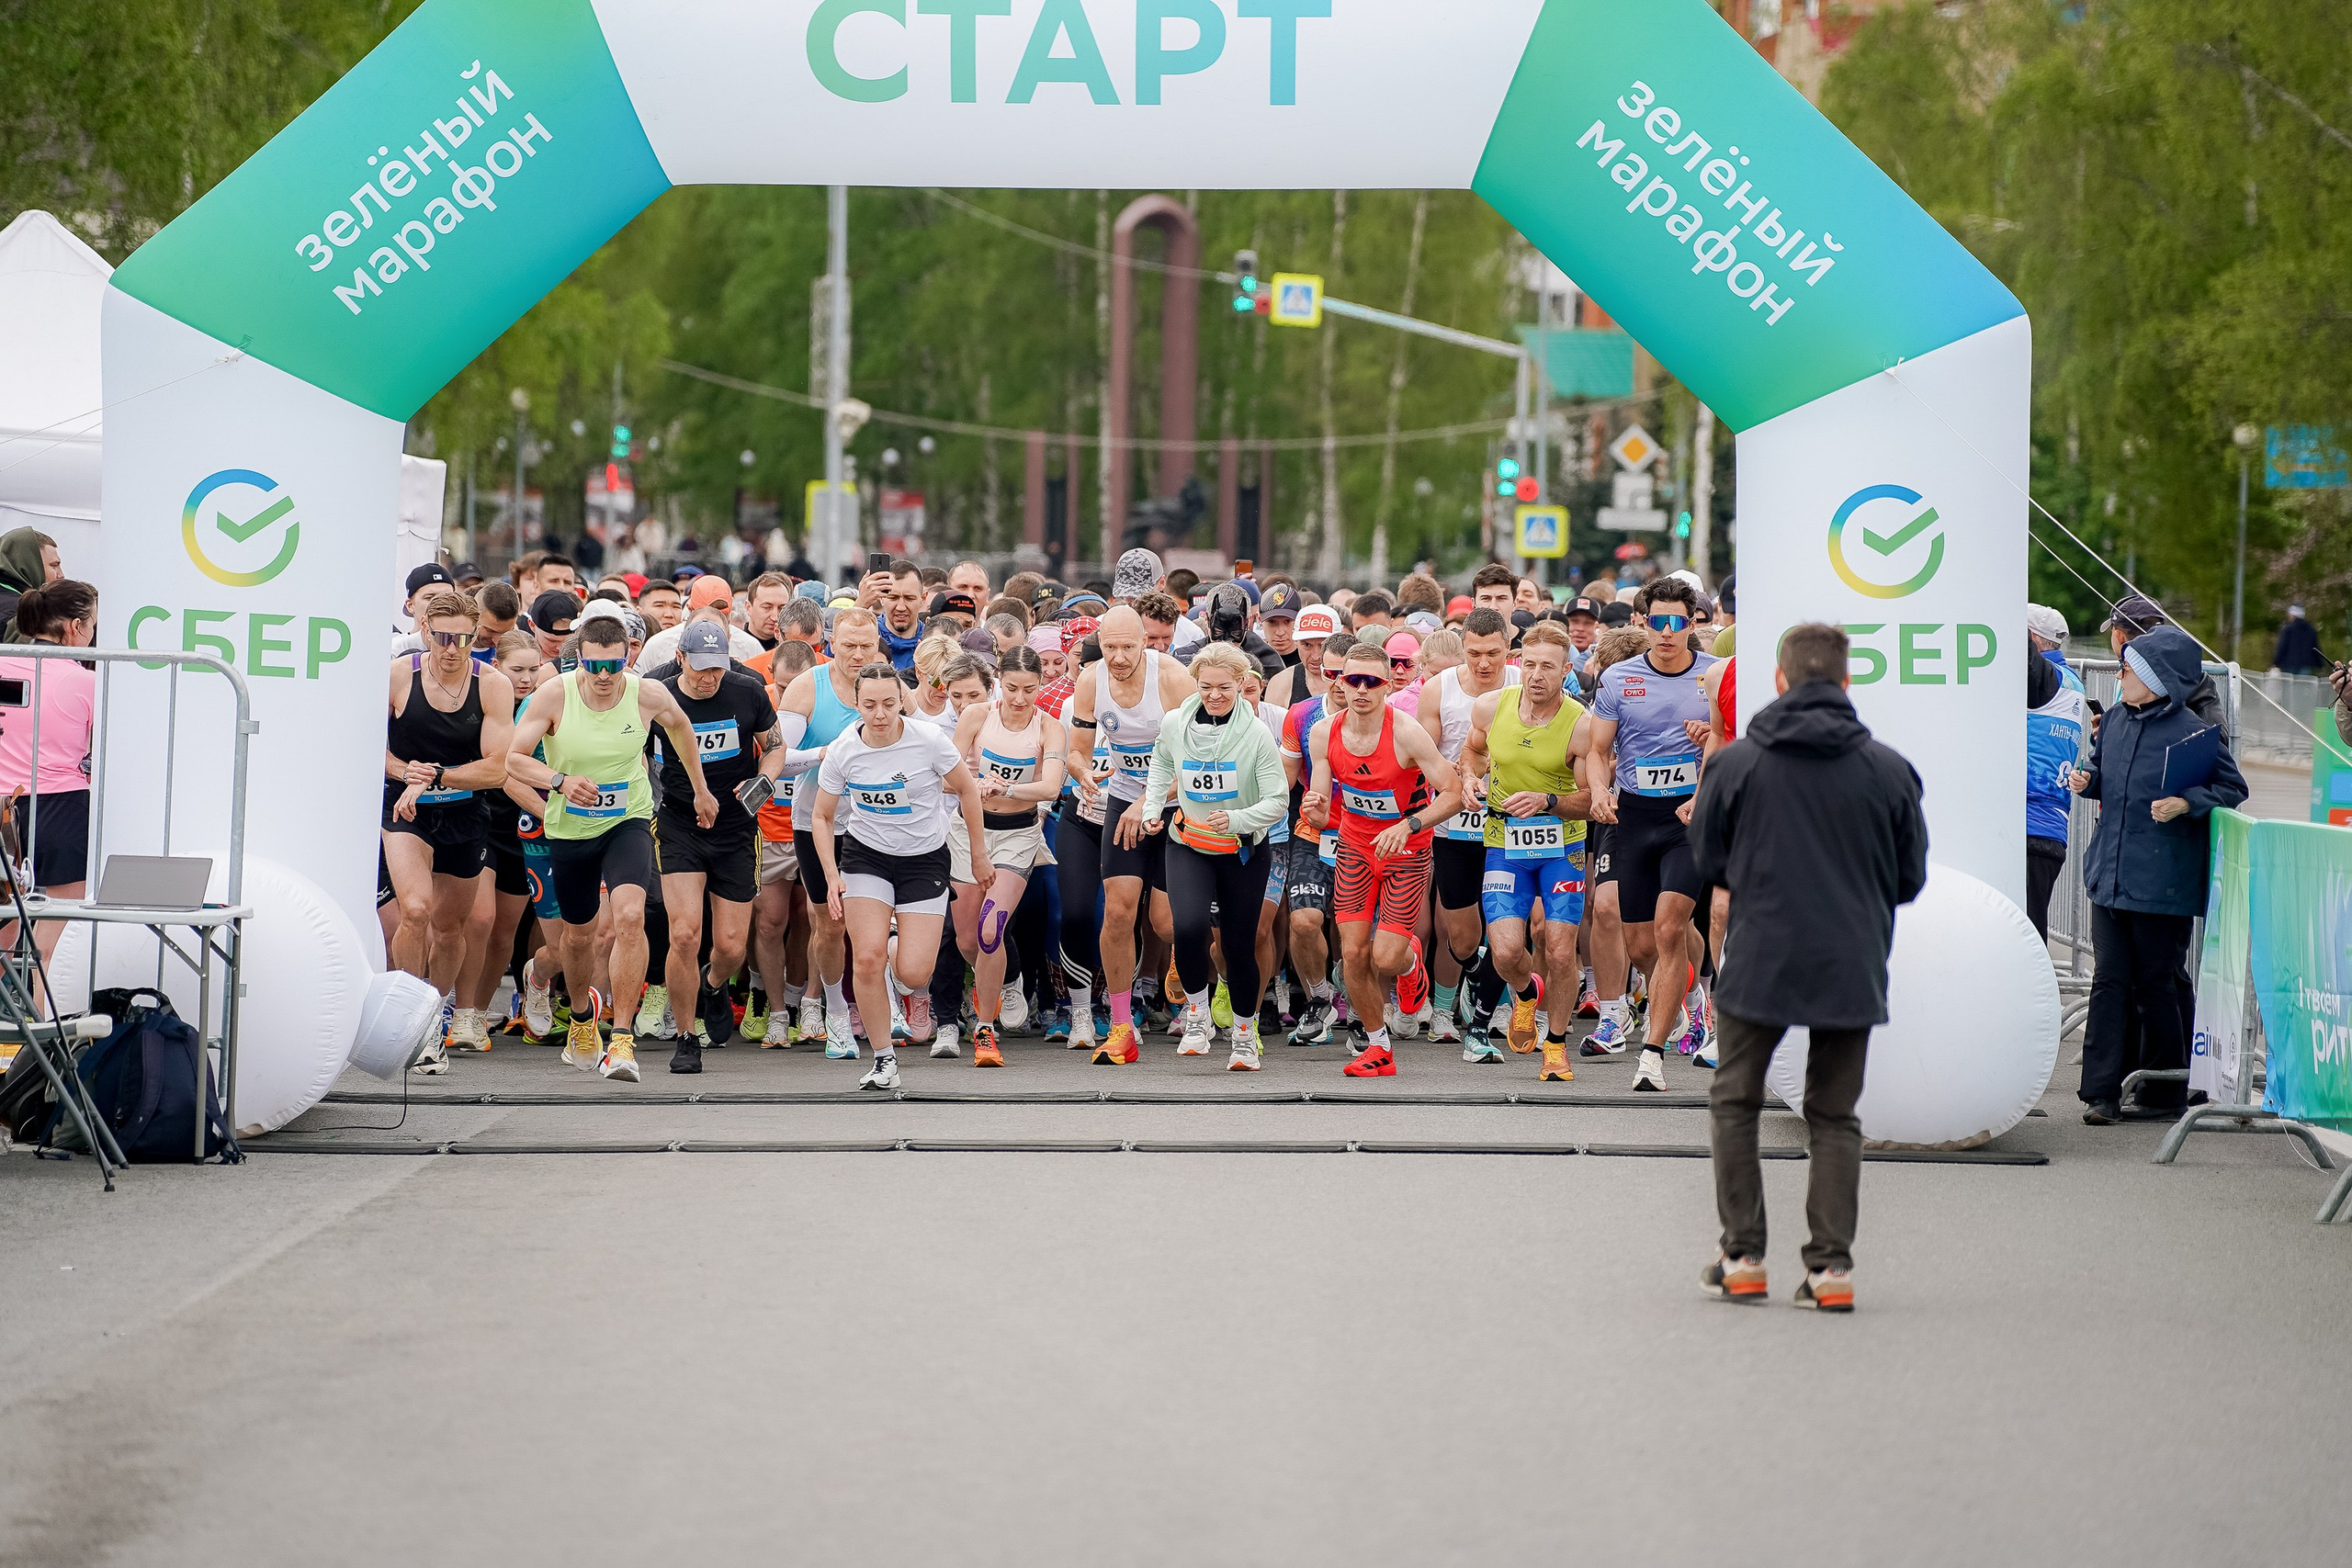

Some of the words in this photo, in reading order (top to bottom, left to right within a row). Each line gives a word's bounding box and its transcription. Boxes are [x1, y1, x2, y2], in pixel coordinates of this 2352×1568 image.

[806, 0, 1332, 106] СТАРТ
[295, 60, 514, 272] зелёный
[1616, 80, 1845, 287] зелёный
[332, 112, 553, 316] марафон
[1575, 118, 1795, 326] марафон
[1301, 616, 1331, 629] ciele
[128, 605, 351, 680] СБЕР
[1776, 623, 1997, 685] БЕР
[989, 762, 1024, 781] 587
[1193, 774, 1224, 790] 681
[1647, 767, 1686, 785] 774
[861, 793, 897, 806] 848
[1352, 796, 1387, 811] 812
[1511, 828, 1558, 846] 1055
[2304, 981, 2341, 1018] твоём
